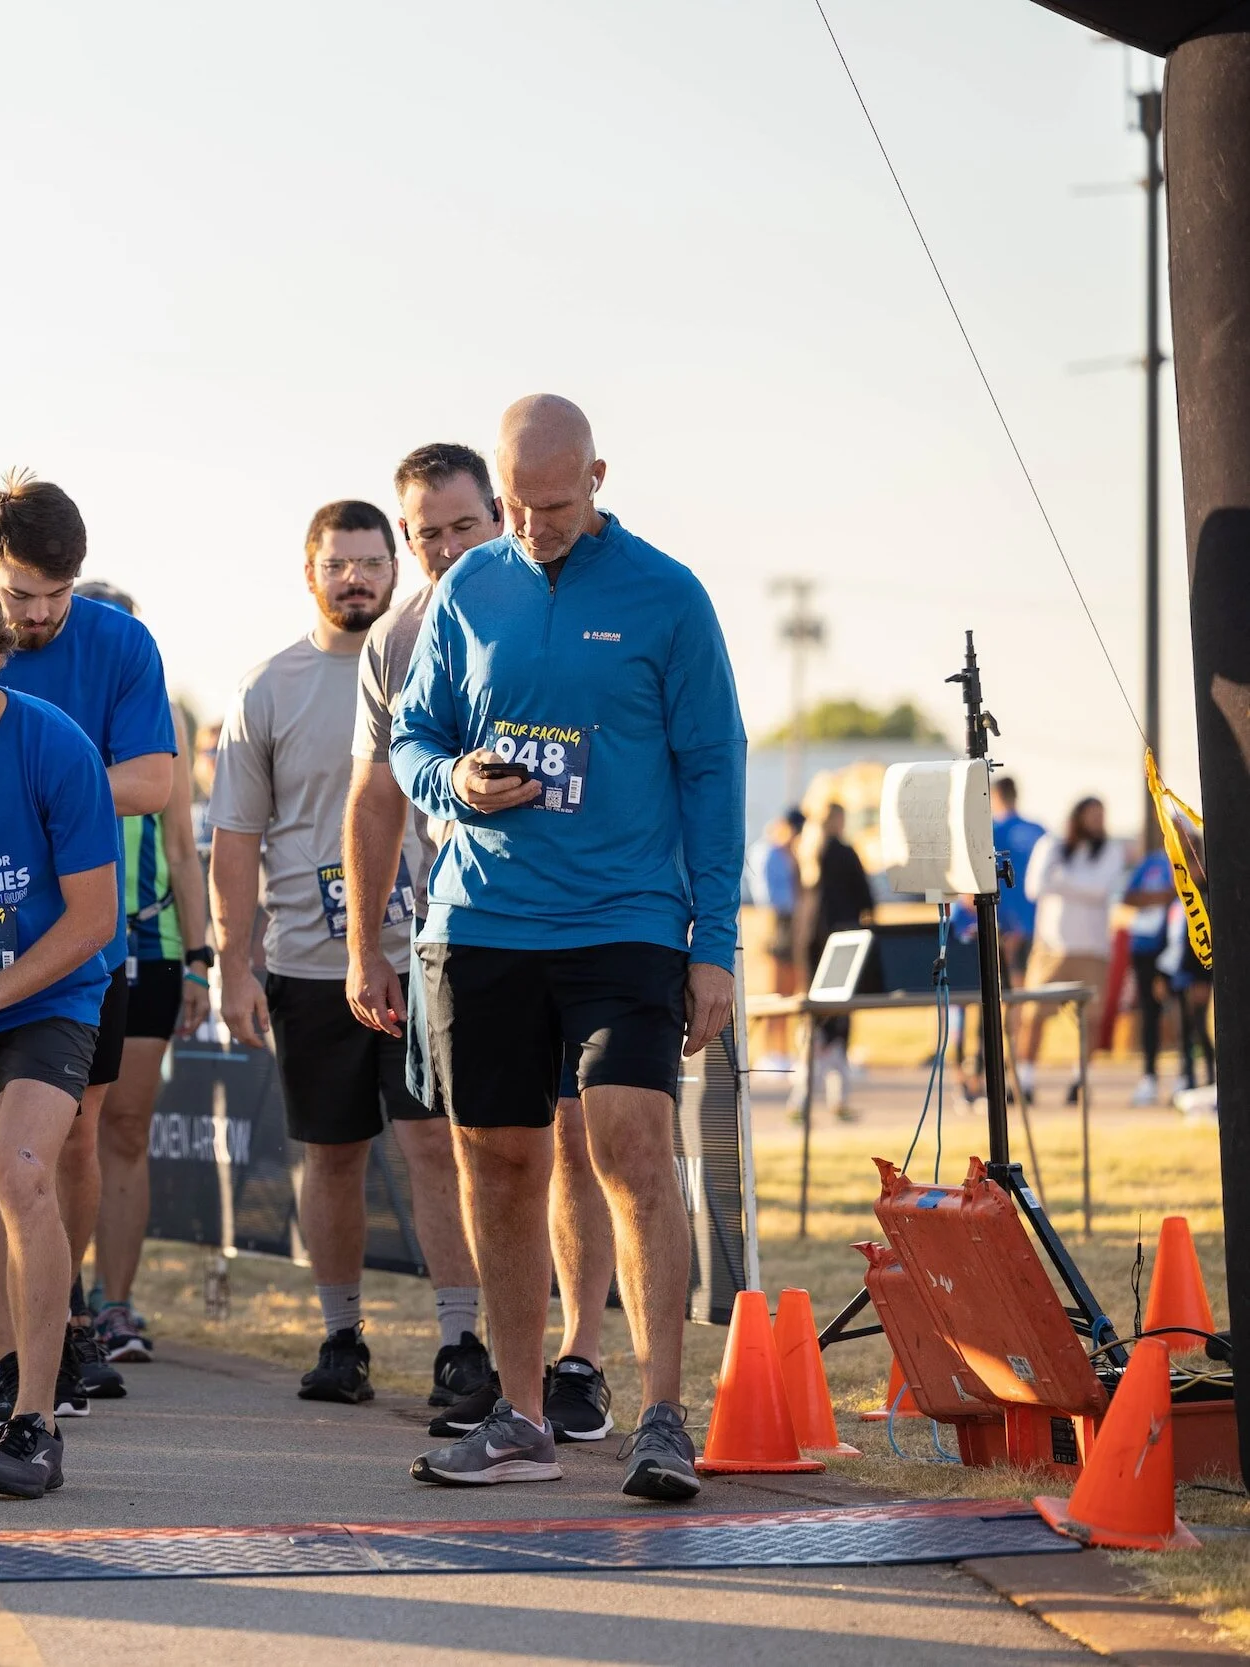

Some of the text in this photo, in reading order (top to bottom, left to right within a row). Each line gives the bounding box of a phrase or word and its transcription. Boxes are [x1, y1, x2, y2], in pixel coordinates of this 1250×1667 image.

[592, 631, 621, 639] ALASKAN
[494, 720, 581, 747] TATUR RACING
[495, 736, 565, 776] 948
[321, 867, 346, 881] TATU
